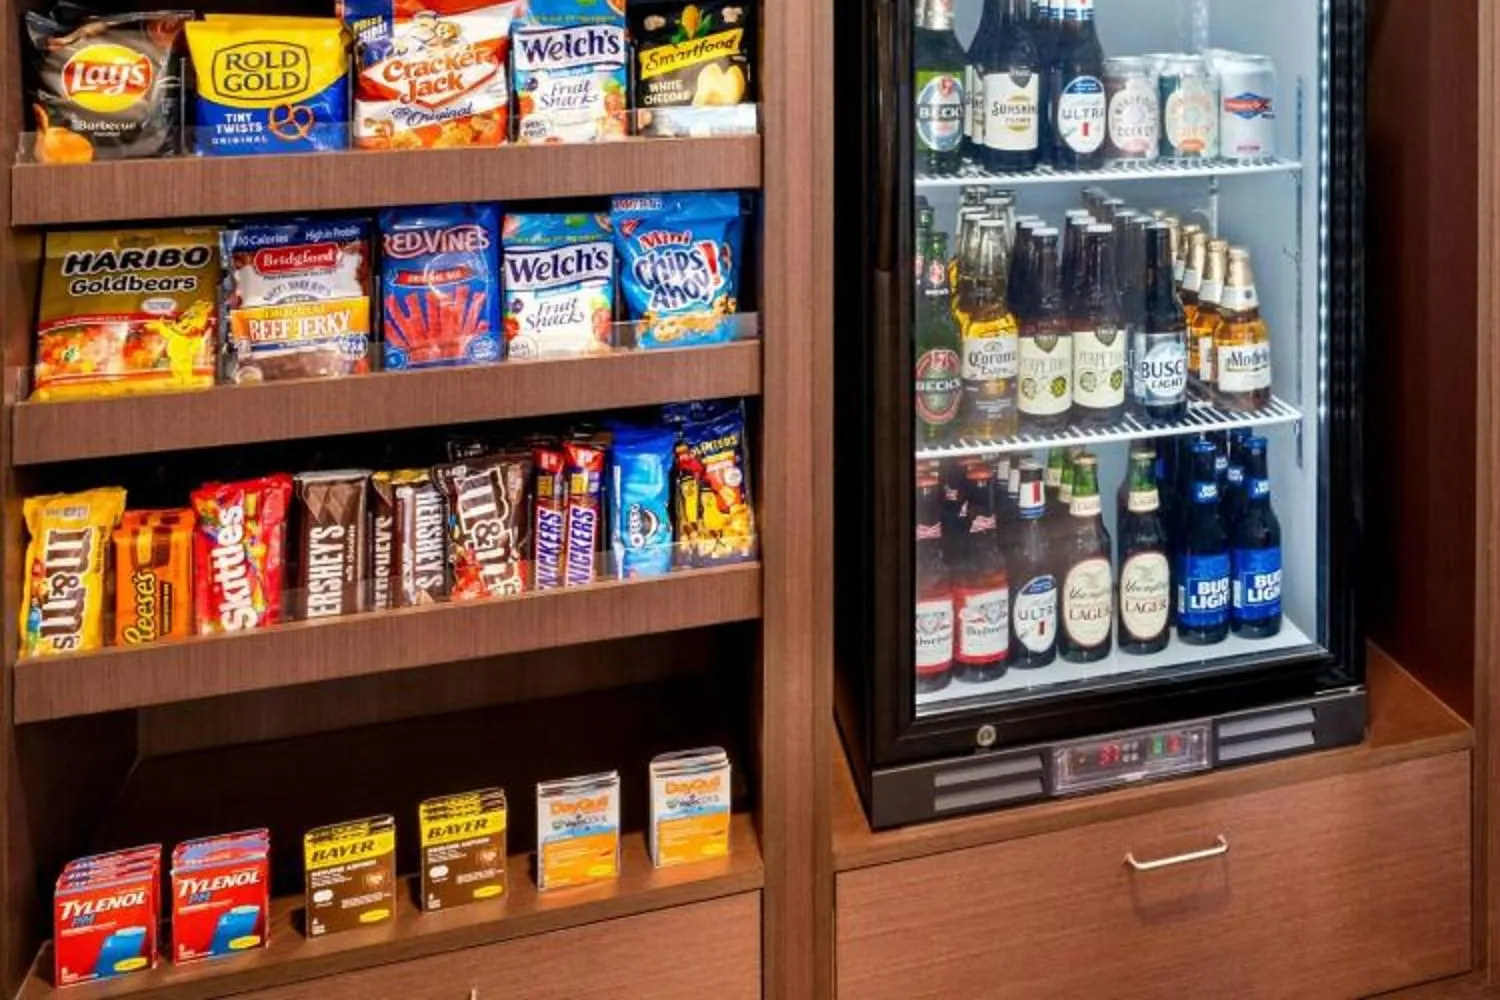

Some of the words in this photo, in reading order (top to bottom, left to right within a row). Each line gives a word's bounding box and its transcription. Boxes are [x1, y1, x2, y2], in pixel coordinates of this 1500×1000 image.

[225, 50, 300, 73] ROLD
[520, 29, 621, 64] Welch's
[645, 35, 738, 72] Smartfood
[70, 62, 147, 95] Lay's
[382, 44, 495, 83] Cracker
[223, 71, 300, 92] GOLD
[400, 71, 466, 105] Jack
[63, 246, 211, 277] HARIBO
[508, 248, 610, 284] Welch's
[70, 276, 196, 296] Goldbears
[298, 311, 351, 339] JERKY
[1141, 359, 1184, 379] BUSC
[536, 507, 563, 588] NICKERS
[566, 506, 596, 588] NICKERS
[308, 525, 345, 618] ERSHEY'S
[1197, 577, 1229, 595] BUD
[1190, 594, 1229, 610] LIGH
[1247, 586, 1281, 604] LIGH
[176, 869, 261, 897] TYLENOL
[60, 890, 145, 920] TYLENOL
